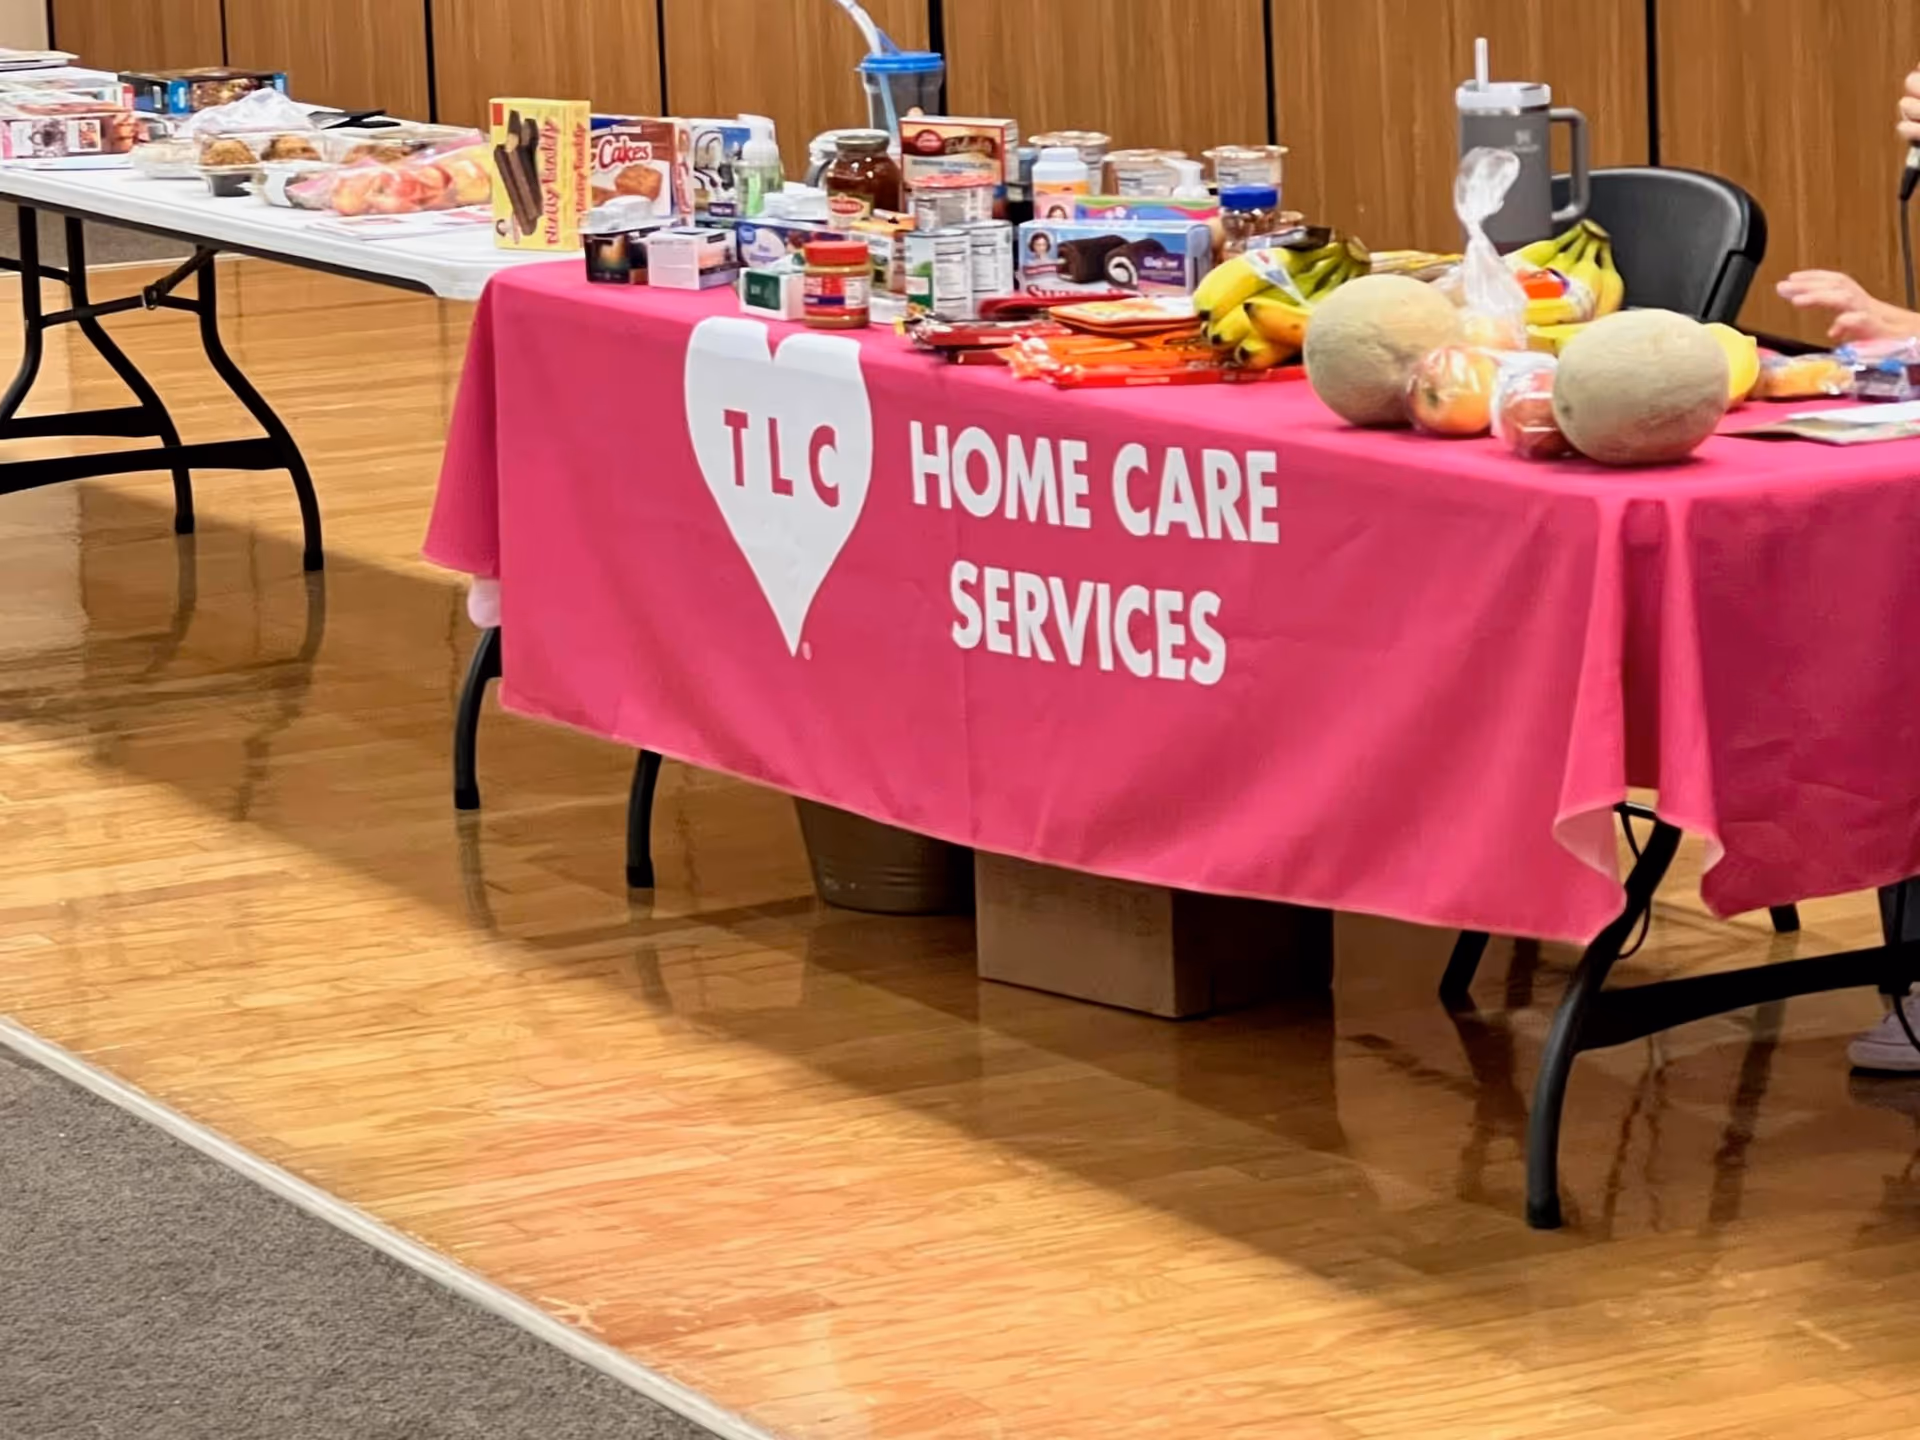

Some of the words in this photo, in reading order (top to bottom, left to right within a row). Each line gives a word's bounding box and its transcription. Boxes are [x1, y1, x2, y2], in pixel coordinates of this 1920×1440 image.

[600, 137, 650, 169] Cakes
[723, 408, 840, 508] TLC
[909, 420, 1091, 529] HOME
[1112, 442, 1280, 545] CARE
[949, 560, 1226, 686] SERVICES
